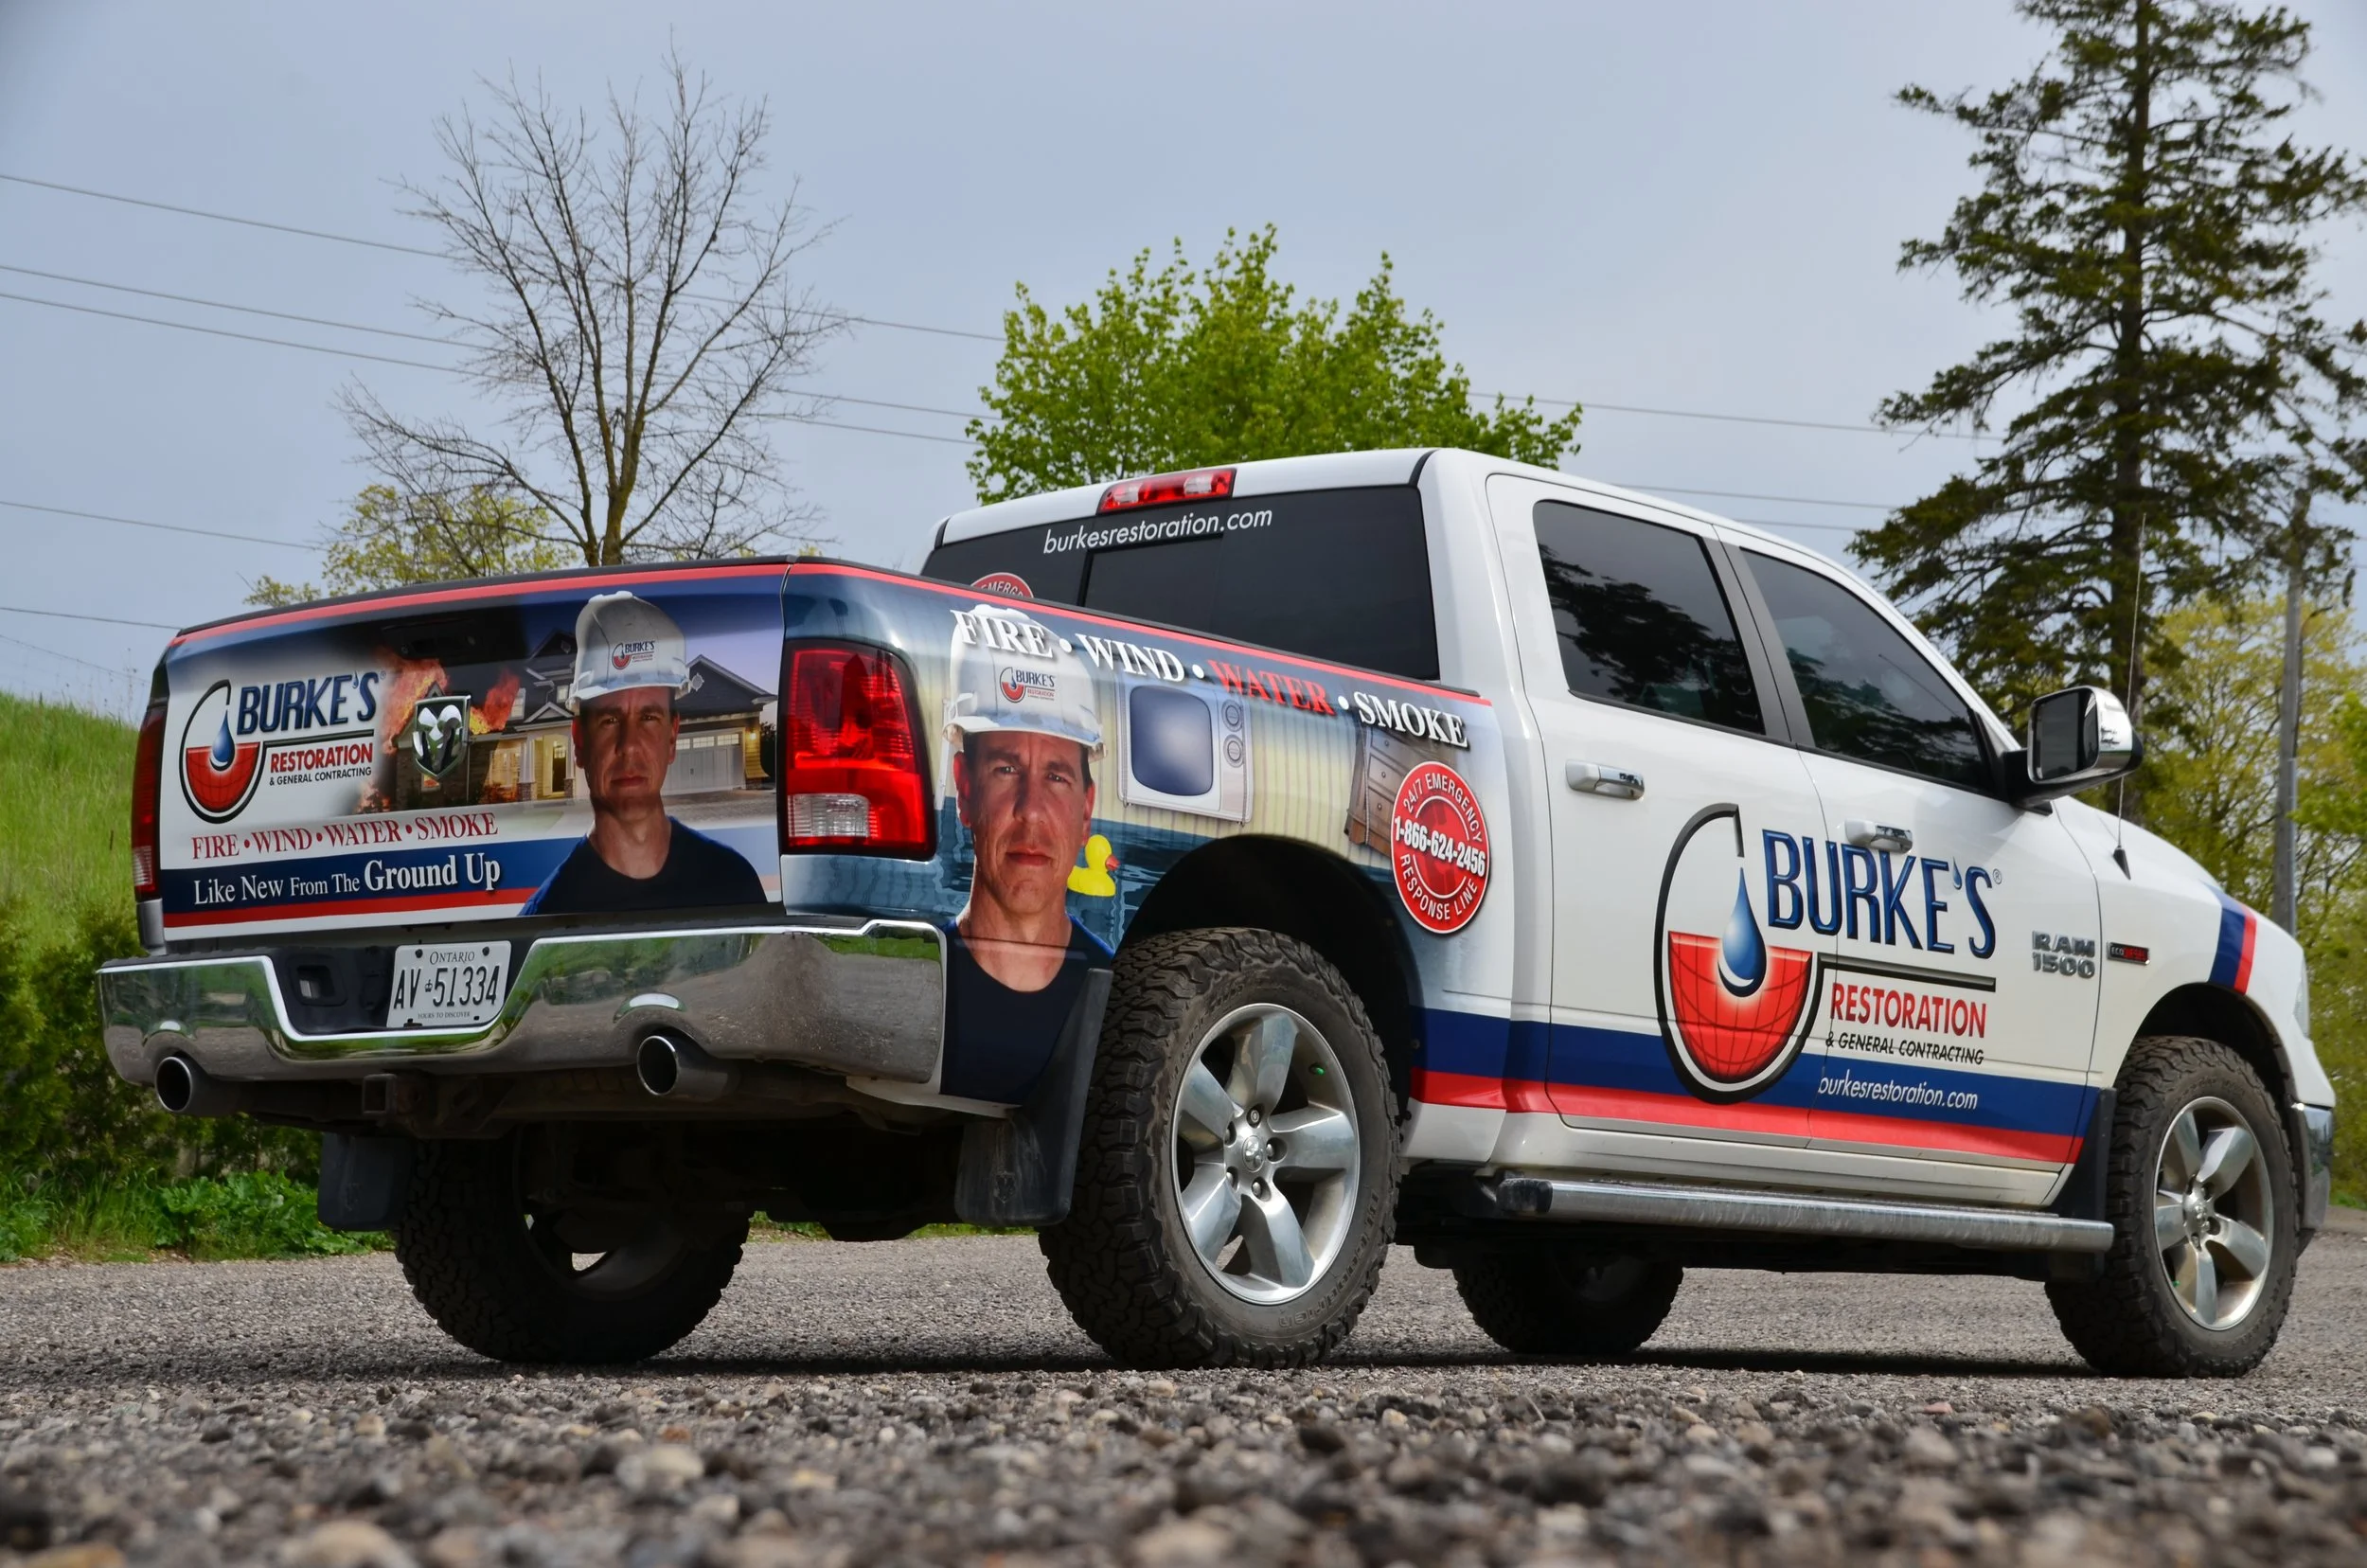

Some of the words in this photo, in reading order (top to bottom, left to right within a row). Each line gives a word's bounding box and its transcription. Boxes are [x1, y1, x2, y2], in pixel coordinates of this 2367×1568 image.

[1043, 509, 1273, 554] burkesrestoration.com
[237, 670, 379, 735] BURKE'S
[950, 609, 1054, 659] FIRE
[1075, 633, 1184, 683] WIND
[1208, 659, 1337, 717] WATER
[1354, 691, 1468, 748] SMOKE
[269, 777, 275, 786] &
[276, 772, 312, 786] GENERAL
[314, 766, 372, 782] CONTRACTING
[270, 742, 373, 773] RESTORATION
[1402, 778, 1422, 814] 24/7
[1425, 772, 1483, 843] EMERGENCY
[191, 833, 240, 860] FIRE
[251, 828, 312, 852] WIND
[323, 819, 402, 847] WATER
[416, 811, 499, 841] SMOKE
[1394, 815, 1486, 878] 1-866-624-2456
[194, 879, 236, 905] Like
[240, 874, 284, 900] New
[290, 876, 329, 897] From
[331, 872, 361, 893] The
[364, 855, 458, 892] Ground
[464, 852, 501, 891] Up
[1399, 853, 1450, 920] RESPONSE
[1454, 878, 1478, 916] LINE
[1762, 829, 1997, 960] BURKE'S
[2032, 930, 2095, 958] RAM
[2032, 952, 2095, 979] 1500
[393, 968, 421, 1009] AV
[433, 965, 500, 1007] 51334
[1830, 982, 1986, 1038] RESTORATION
[1825, 1031, 1834, 1048] &
[1839, 1032, 1894, 1055] GENERAL
[1898, 1040, 1984, 1065] CONTRACTING
[1818, 1065, 1979, 1110] burkesrestoration.com
